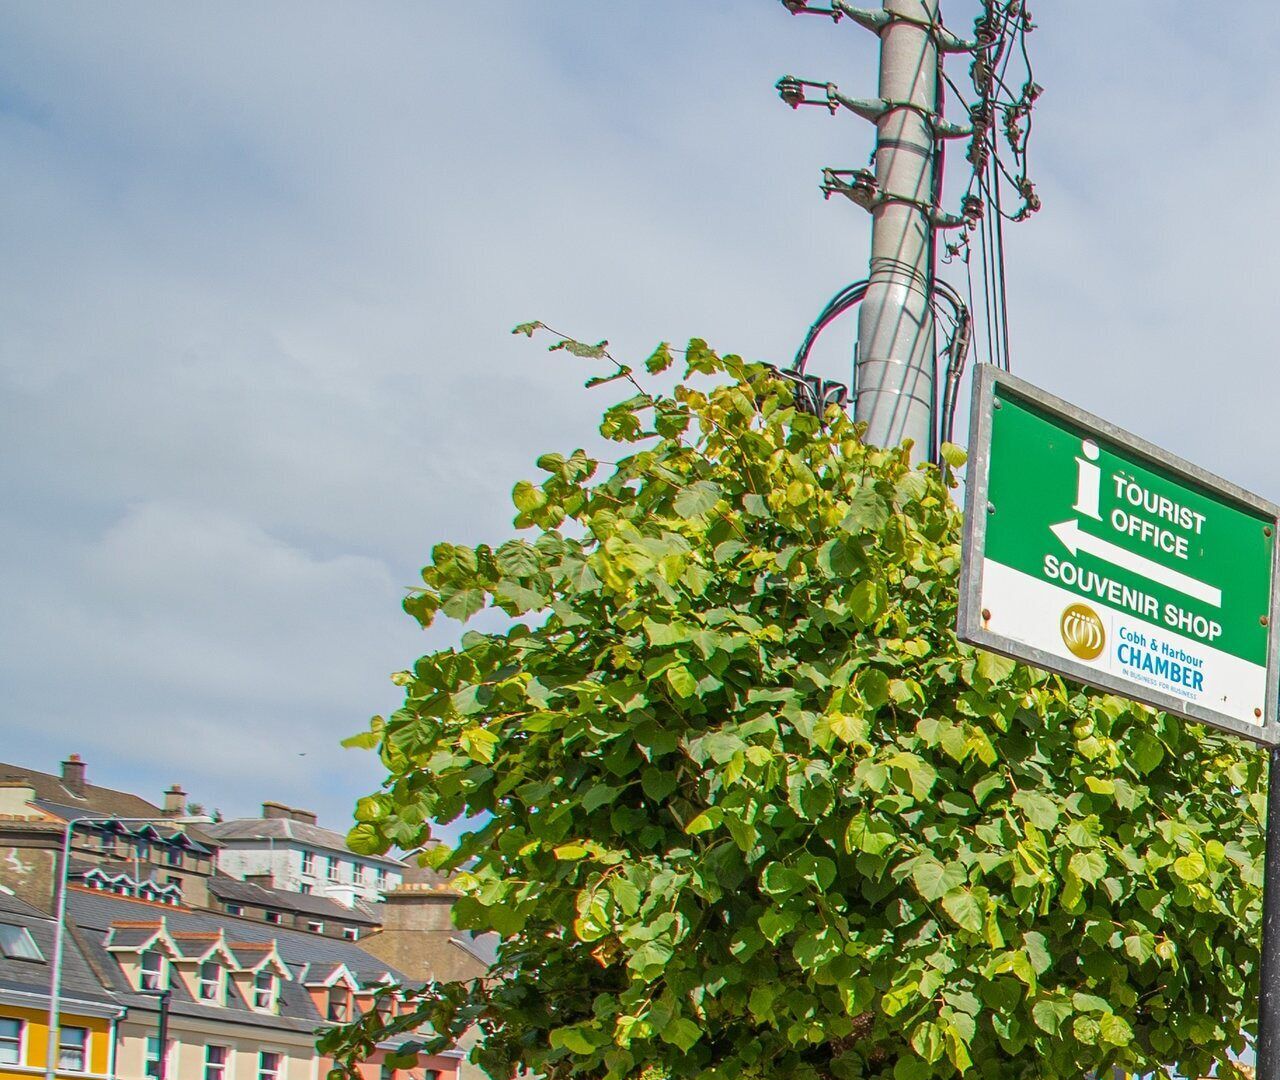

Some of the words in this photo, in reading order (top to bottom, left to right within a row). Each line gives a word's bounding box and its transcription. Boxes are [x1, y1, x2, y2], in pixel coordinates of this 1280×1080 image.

[1112, 474, 1206, 535] TOURIST
[1111, 509, 1189, 560] OFFICE
[1043, 554, 1159, 620] SOUVENIR
[1164, 603, 1223, 641] SHOP
[1117, 643, 1204, 692] CHAMBER
[1119, 626, 1146, 648] Cobh
[1150, 638, 1158, 652] &
[1161, 642, 1204, 668] Harbour
[1130, 671, 1158, 687] BUSINESS
[1158, 681, 1172, 691] FOR
[1171, 684, 1198, 700] BUSINESS
